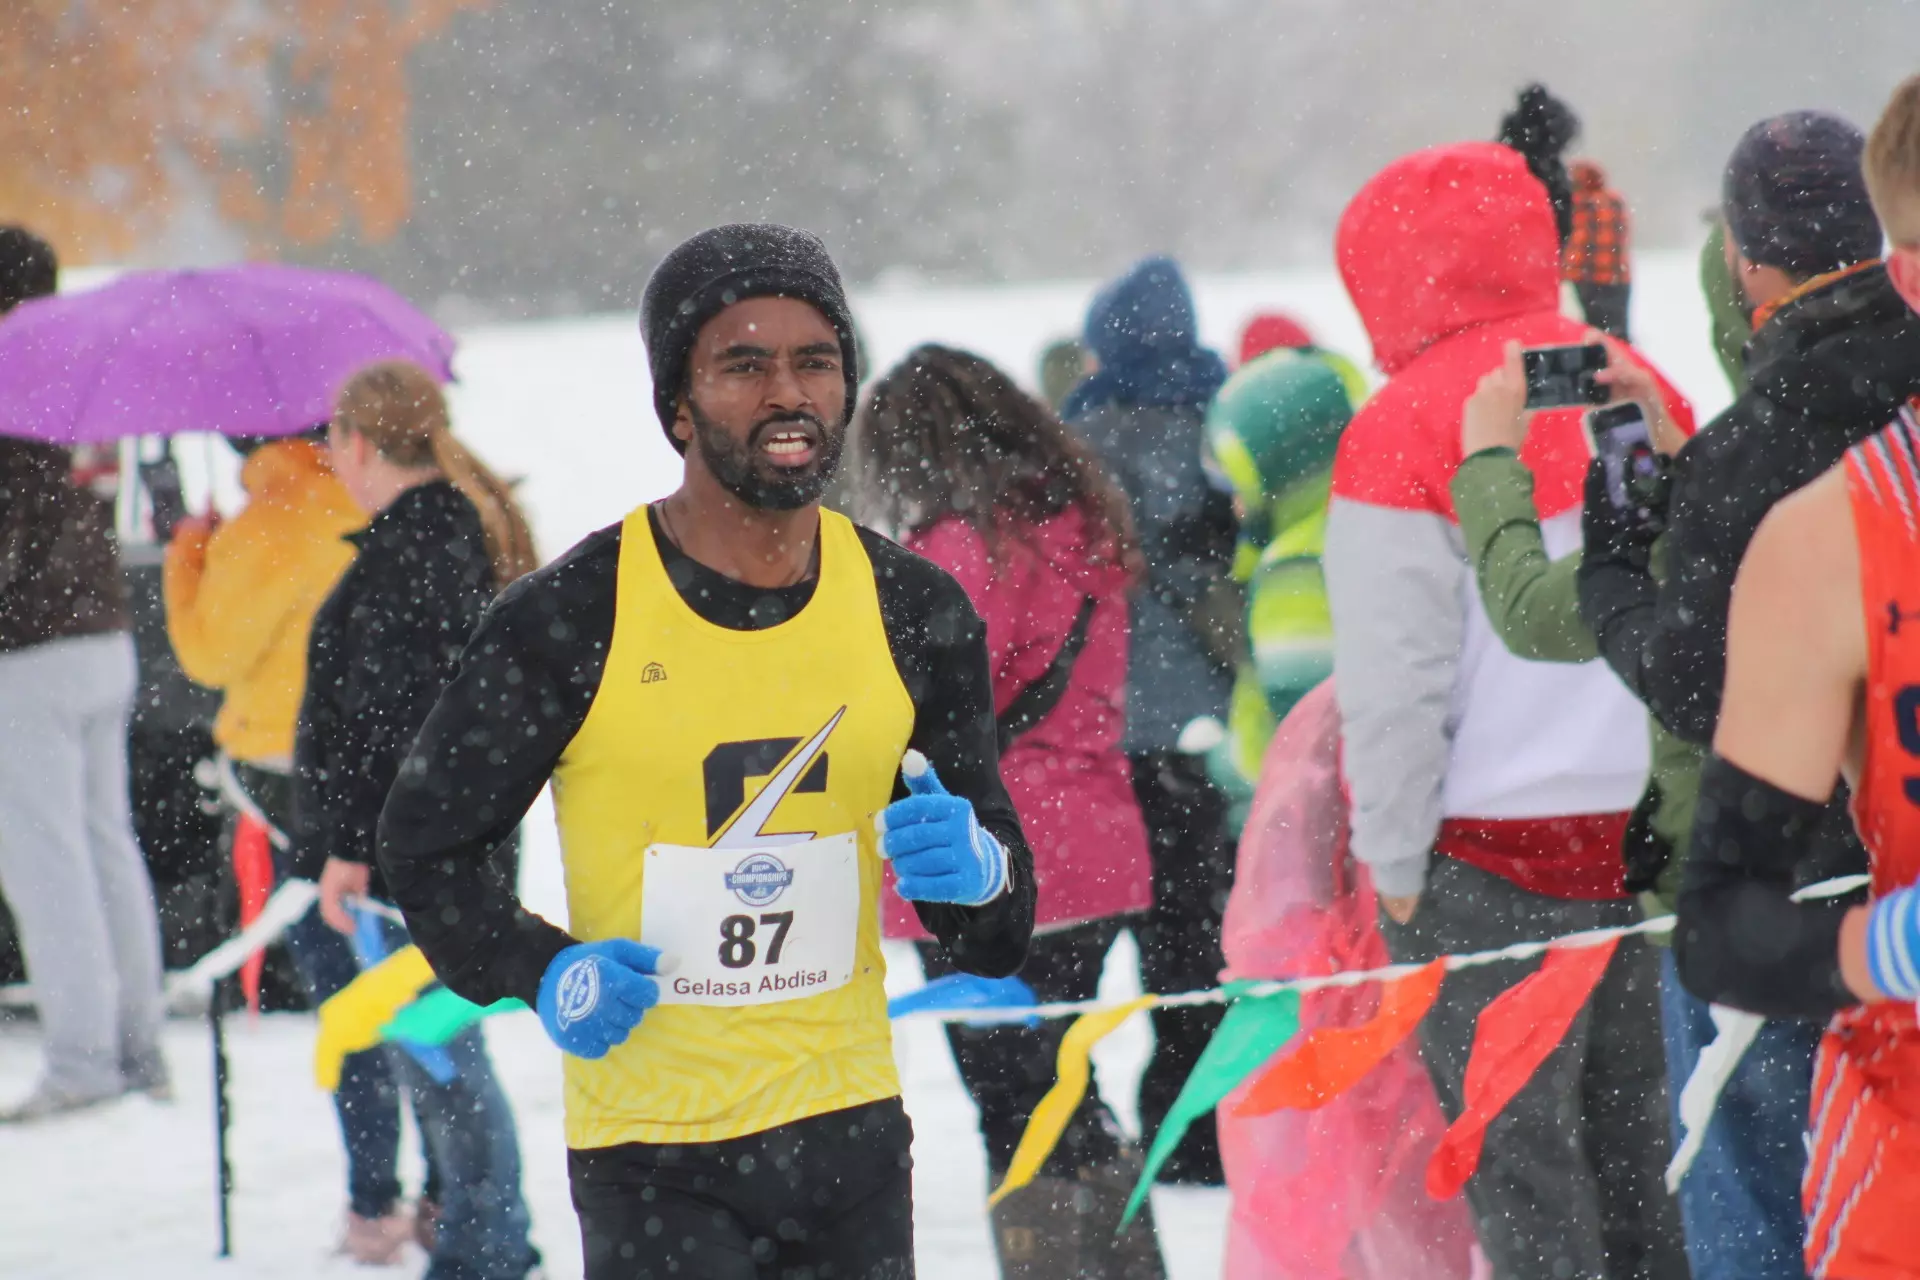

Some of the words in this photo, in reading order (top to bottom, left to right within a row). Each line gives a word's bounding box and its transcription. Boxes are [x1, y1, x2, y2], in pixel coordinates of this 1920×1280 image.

[731, 870, 788, 885] CHAMPIONSHIPS
[717, 910, 794, 969] 87
[672, 977, 751, 996] Gelasa
[757, 969, 828, 993] Abdisa
